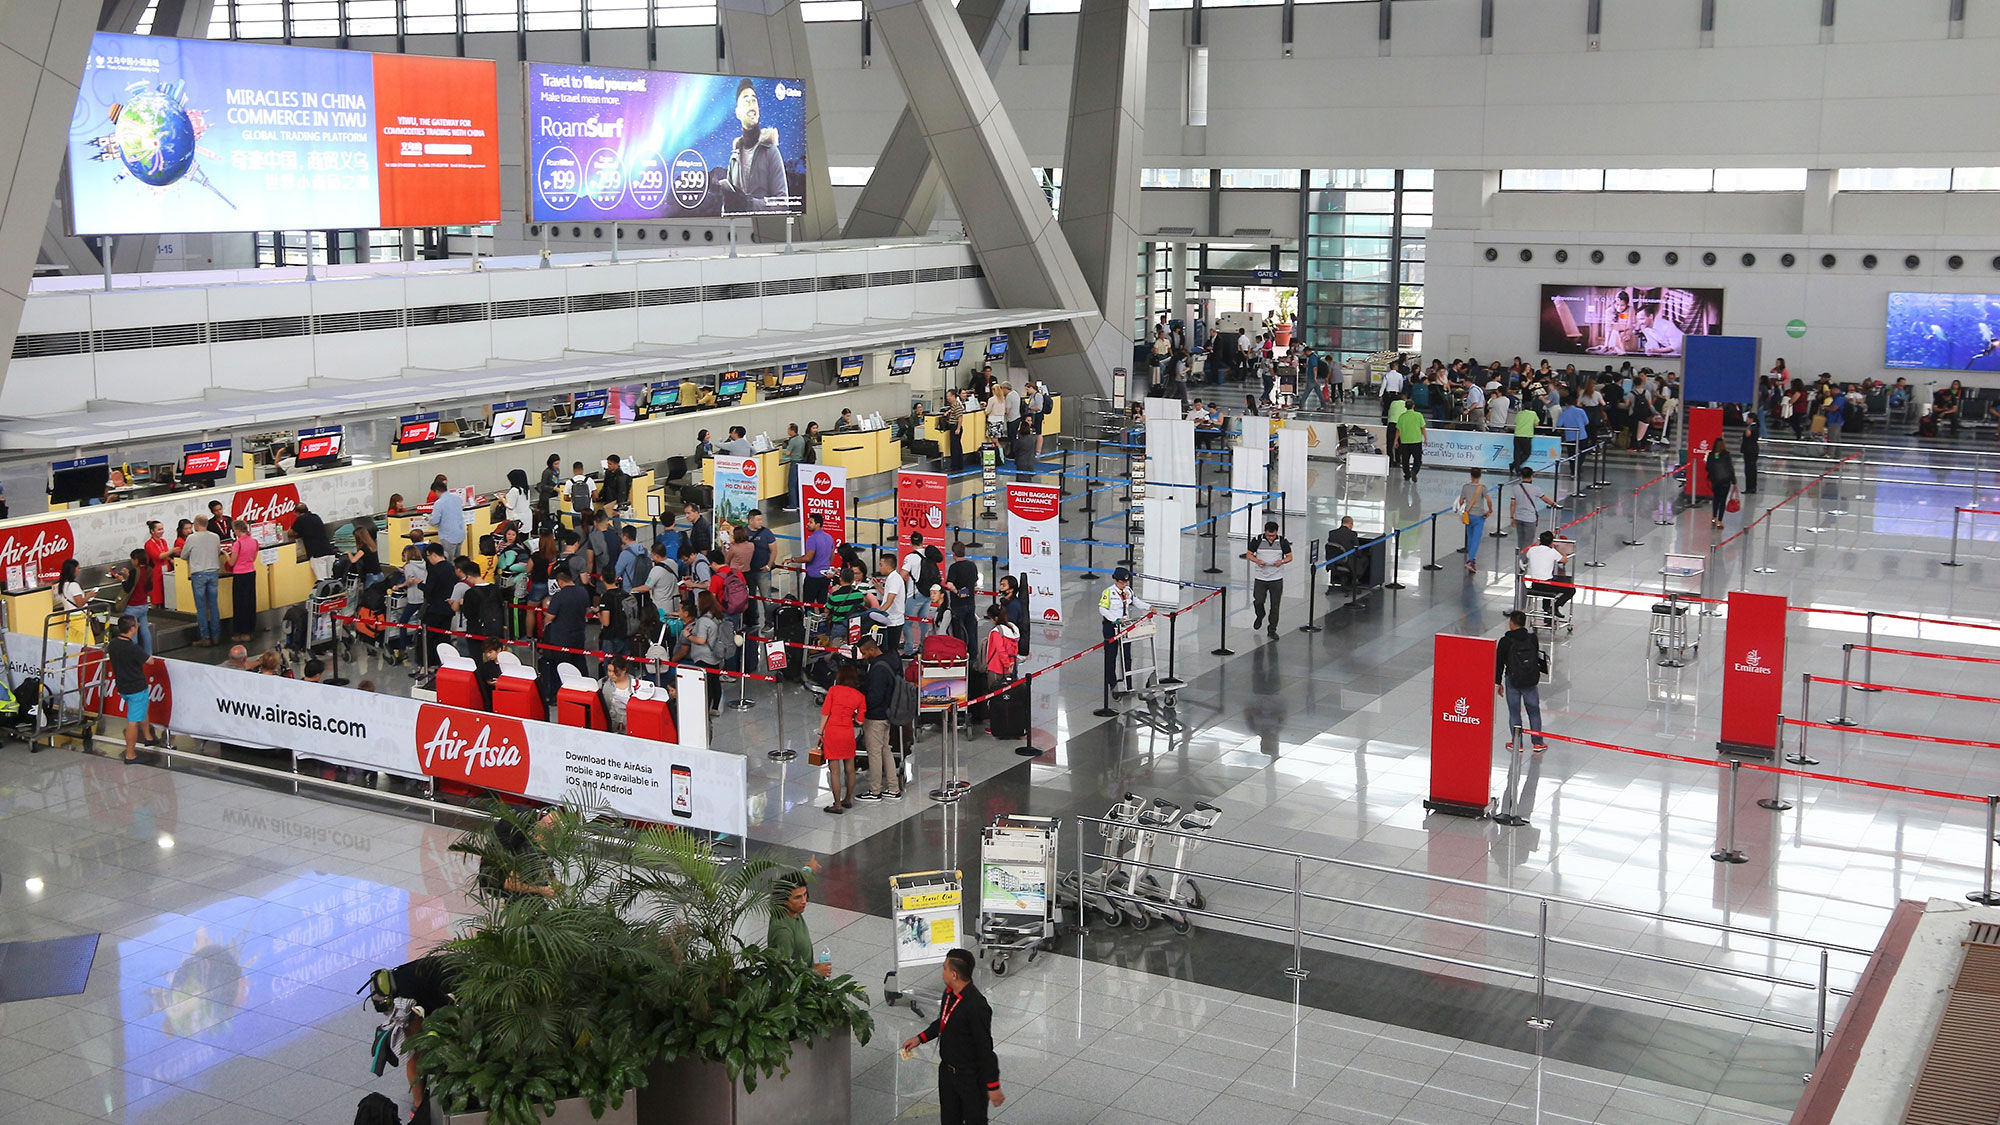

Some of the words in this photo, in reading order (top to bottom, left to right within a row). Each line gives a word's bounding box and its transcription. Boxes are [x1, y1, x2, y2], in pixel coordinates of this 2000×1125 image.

[540, 73, 571, 88] Travel
[571, 75, 582, 88] to
[583, 75, 605, 90] find
[226, 88, 299, 107] MIRACLES
[301, 92, 318, 108] IN
[321, 93, 367, 110] CHINA
[540, 92, 560, 102] Make
[561, 93, 580, 103] travel
[581, 95, 600, 104] mean
[227, 107, 311, 126] COMMERCE
[313, 110, 328, 127] IN
[332, 112, 367, 128] YIWU
[397, 116, 419, 126] YIWU,
[419, 118, 431, 126] THE
[431, 118, 459, 127] GATEWAY
[459, 119, 472, 127] FOR
[383, 127, 425, 135] COMMODITIES
[466, 129, 486, 137] CHINA
[541, 116, 624, 138] RoamSurf
[241, 129, 279, 141] GLOBAL
[280, 131, 321, 142] TRADING
[322, 131, 368, 143] PLATFORM
[1441, 451, 1455, 460] Way
[1457, 451, 1464, 459] to
[1466, 452, 1475, 461] Fly
[1015, 497, 1053, 505] ALLOWANCE
[1028, 492, 1058, 500] BAGGAGE
[807, 498, 834, 508] ZONE
[835, 500, 840, 508] 1
[901, 508, 928, 517] WITH
[0, 530, 69, 566] AirAsia
[1735, 663, 1771, 675] Emirates
[216, 697, 367, 739] www.airasia.com
[1443, 712, 1481, 725] Emirates
[565, 751, 606, 766] Download
[608, 758, 621, 769] the
[623, 762, 653, 774] AirAsia
[565, 765, 594, 776] mobile
[595, 770, 611, 780] app
[613, 772, 650, 787] available
[651, 778, 659, 788] in
[566, 776, 580, 786] iOS
[582, 779, 598, 789] and
[600, 782, 633, 796] Android
